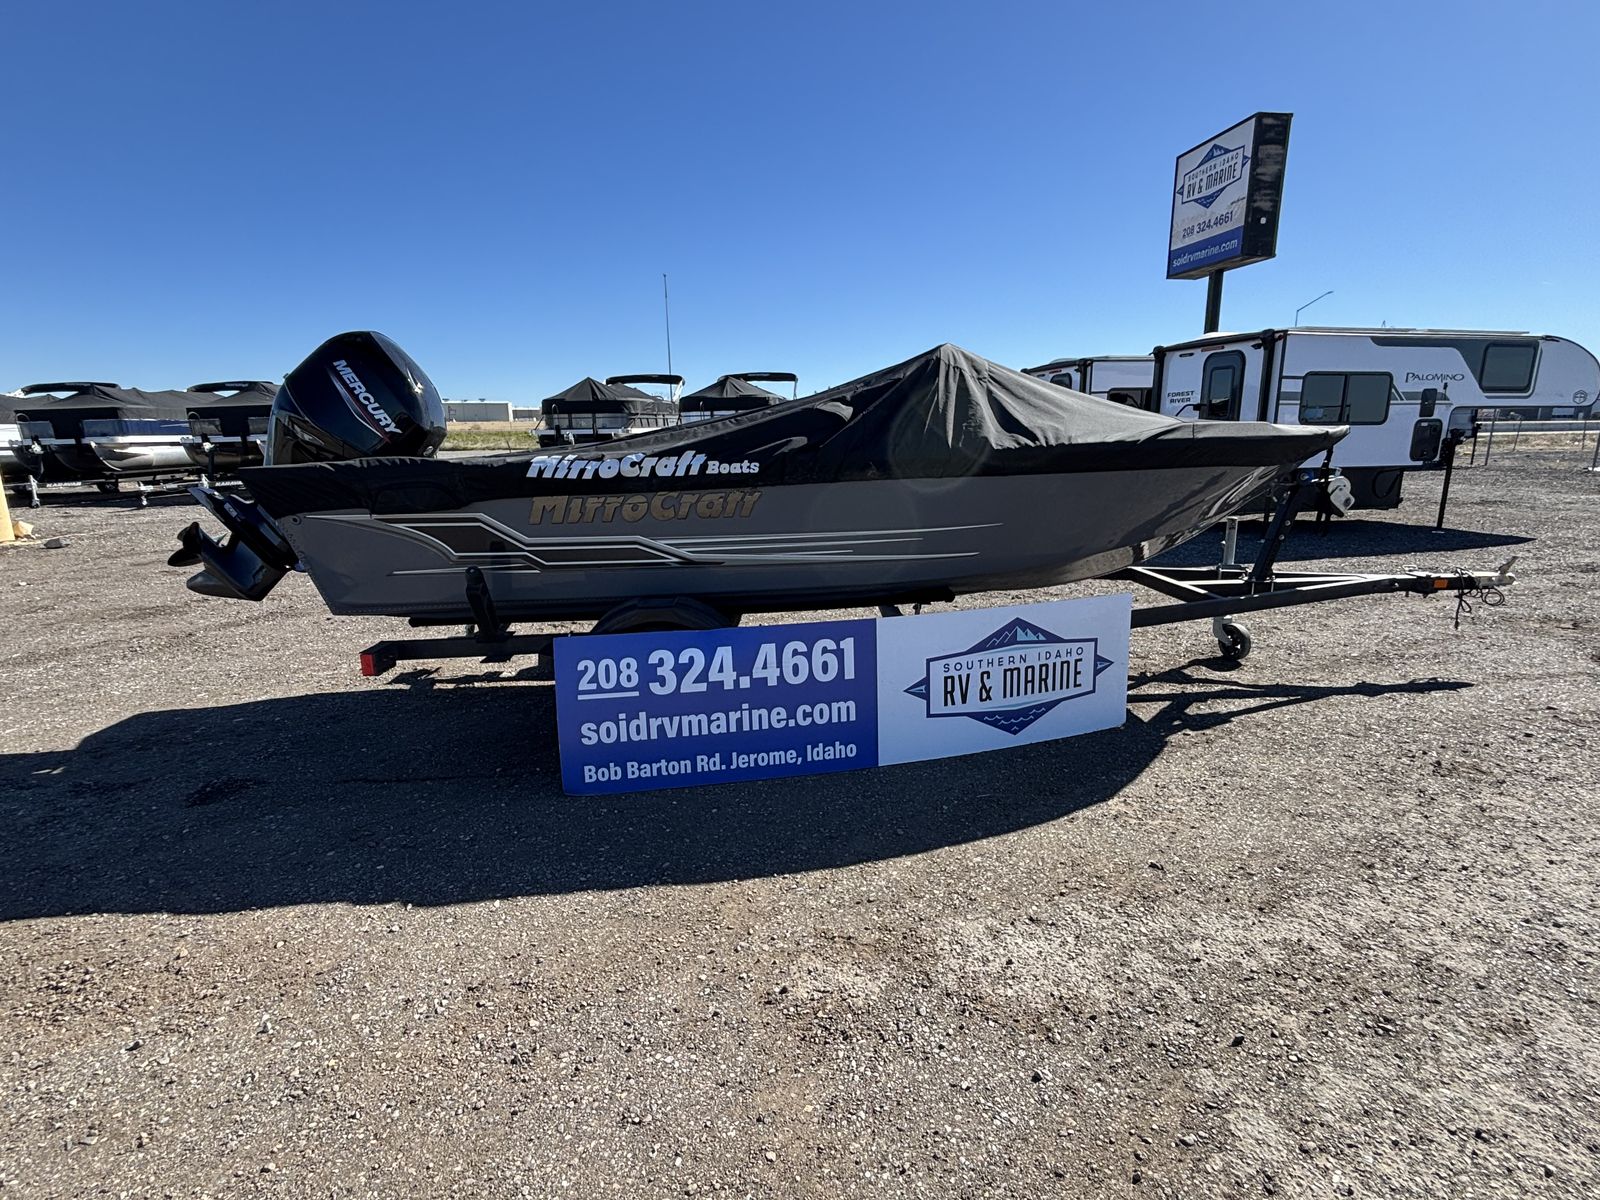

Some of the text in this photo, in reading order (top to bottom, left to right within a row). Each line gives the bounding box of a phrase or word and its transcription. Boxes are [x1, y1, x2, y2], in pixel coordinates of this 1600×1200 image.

[1186, 161, 1238, 199] RV & MARINE
[1188, 152, 1239, 182] SOUTHERN IDAHO
[1182, 210, 1234, 239] 208 324.4661
[1172, 240, 1238, 267] soidrvmarine.com
[333, 359, 403, 434] MERCURY
[1167, 390, 1195, 398] FOREST
[526, 450, 760, 479] MirroCraft Boats
[528, 489, 763, 525] MirroCraft
[577, 637, 856, 695] 208 324.4661
[943, 646, 1084, 673] SOUTHERN IDAHO
[943, 658, 1083, 707] RV & MARINE
[581, 700, 856, 745] soidrvmarine.com
[584, 741, 857, 783] Bob Barton Rd. Jerome, Idaho
